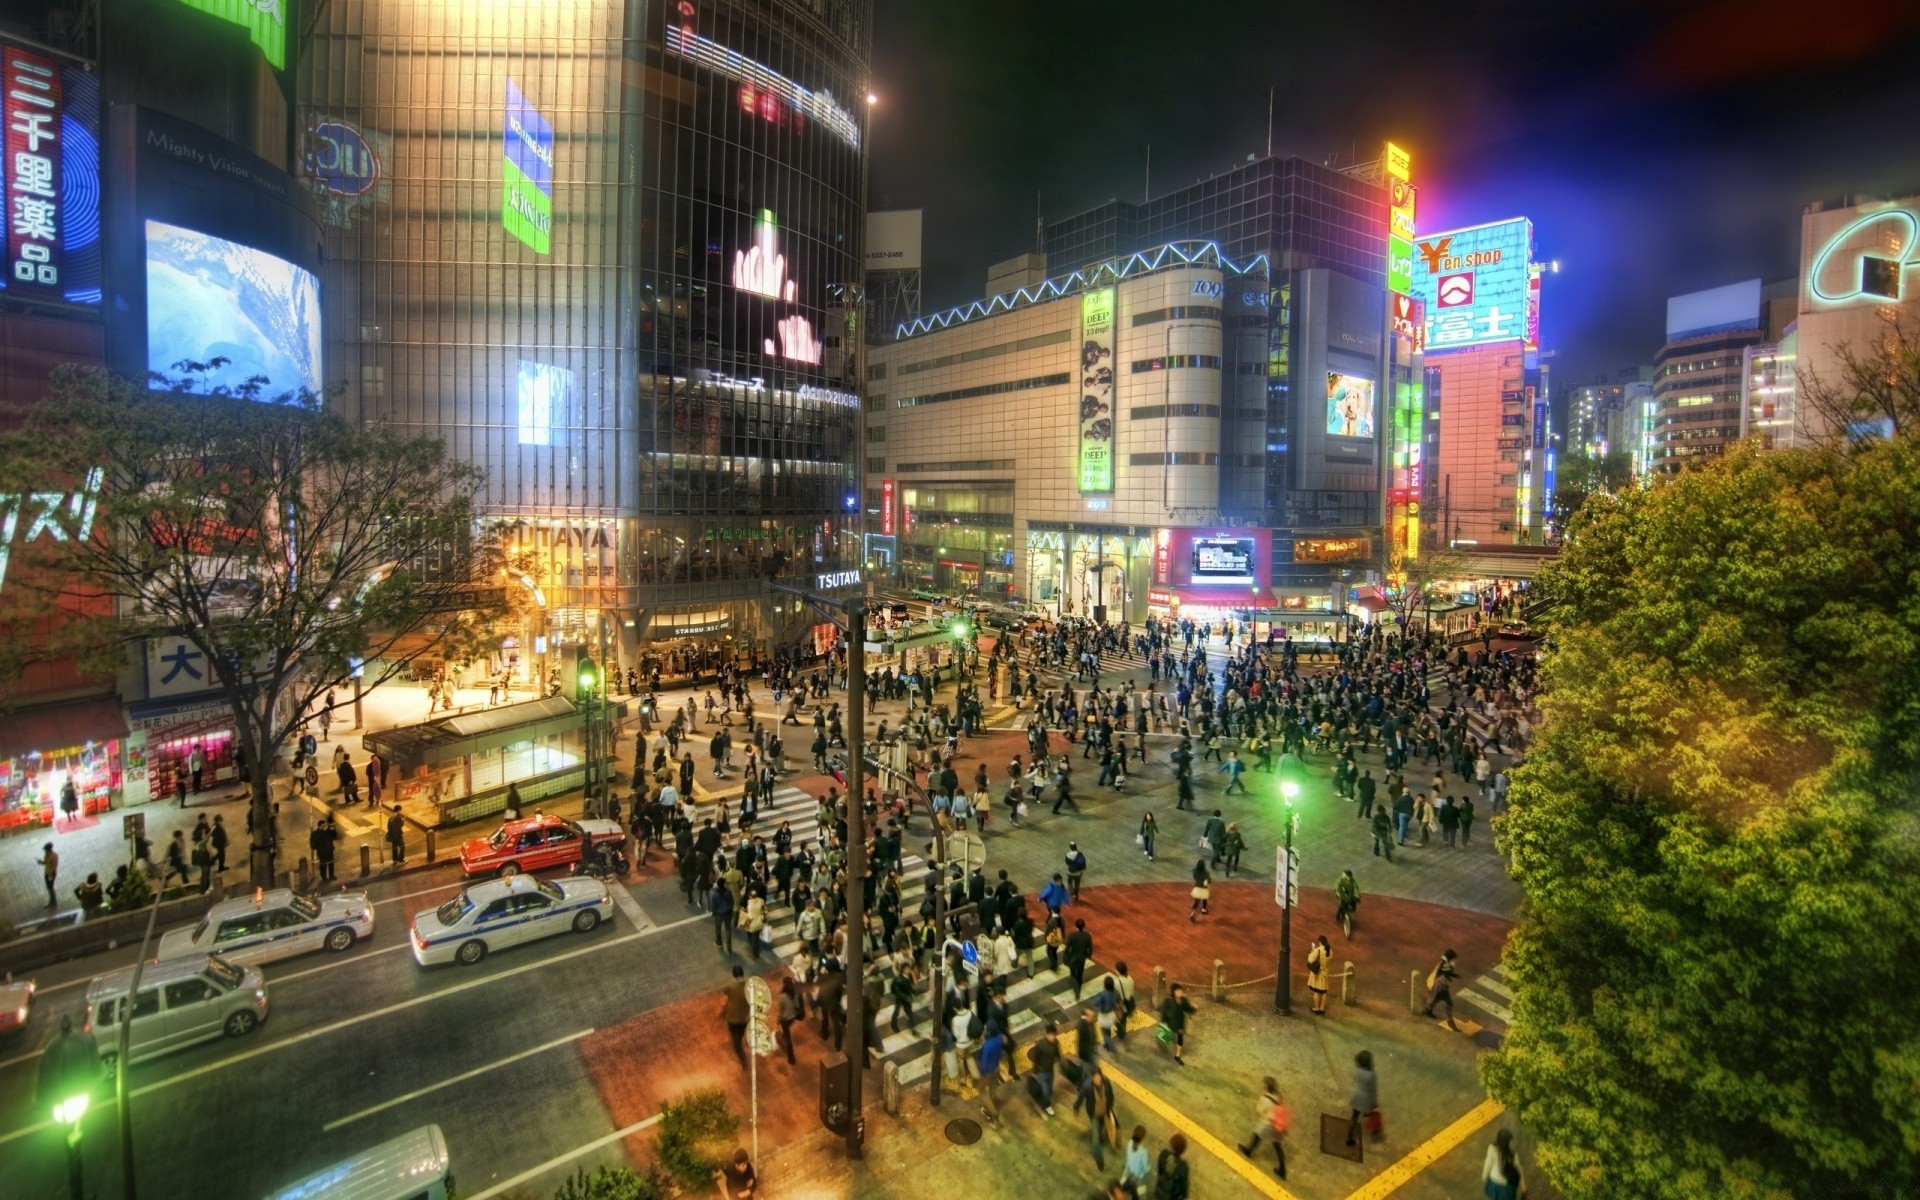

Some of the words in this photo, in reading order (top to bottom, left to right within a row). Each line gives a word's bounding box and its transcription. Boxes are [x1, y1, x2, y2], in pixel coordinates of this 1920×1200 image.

[147, 128, 205, 163] Mighty
[208, 152, 249, 178] Vision
[11, 60, 57, 285] 三千里薬品
[1465, 249, 1502, 267] shop
[1087, 311, 1109, 324] DEEP
[1084, 450, 1107, 460] DEEP
[819, 569, 861, 589] TSUTAYA
